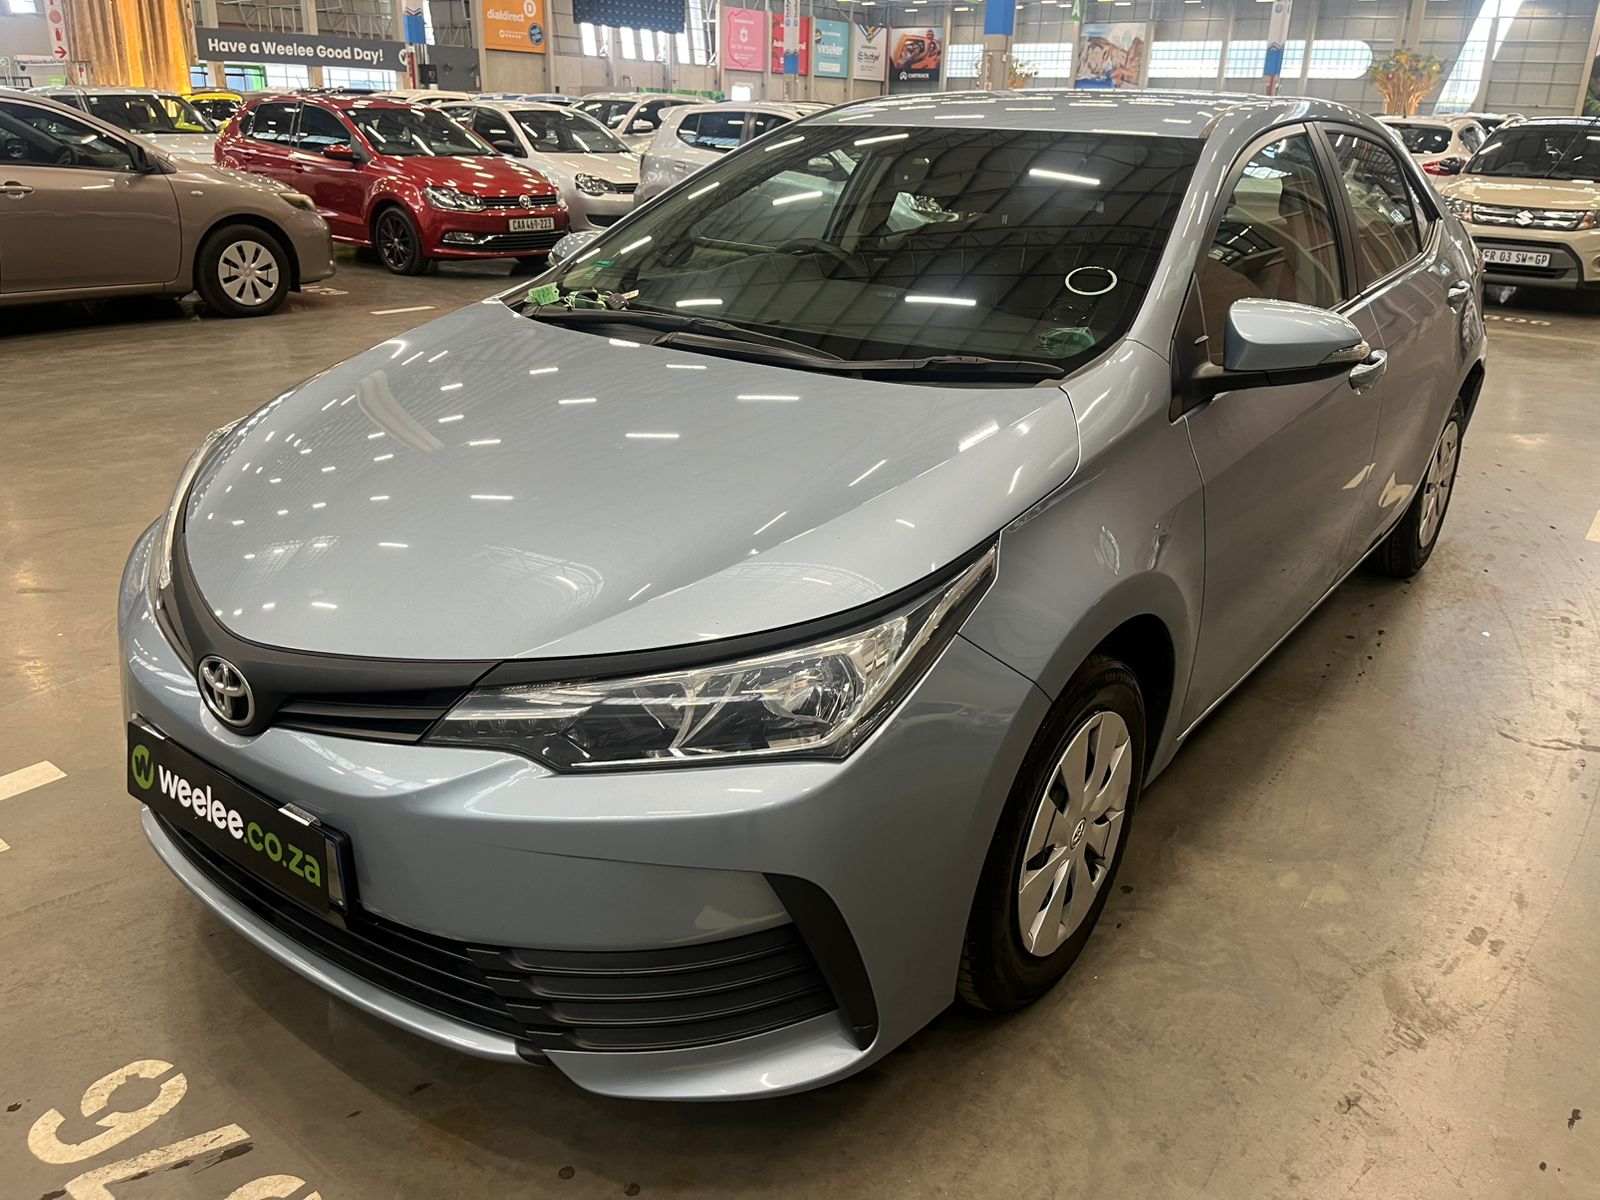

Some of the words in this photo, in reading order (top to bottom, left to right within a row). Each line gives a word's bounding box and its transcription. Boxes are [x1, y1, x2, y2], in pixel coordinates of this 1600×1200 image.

[487, 9, 525, 22] dialdirect
[207, 38, 247, 54] Have
[249, 42, 260, 54] a
[262, 41, 315, 58] Weelee
[316, 45, 352, 60] Good
[354, 49, 384, 65] Day!
[1499, 251, 1512, 262] 03
[1534, 254, 1548, 265] GP
[158, 763, 321, 888] weelee.co.za
